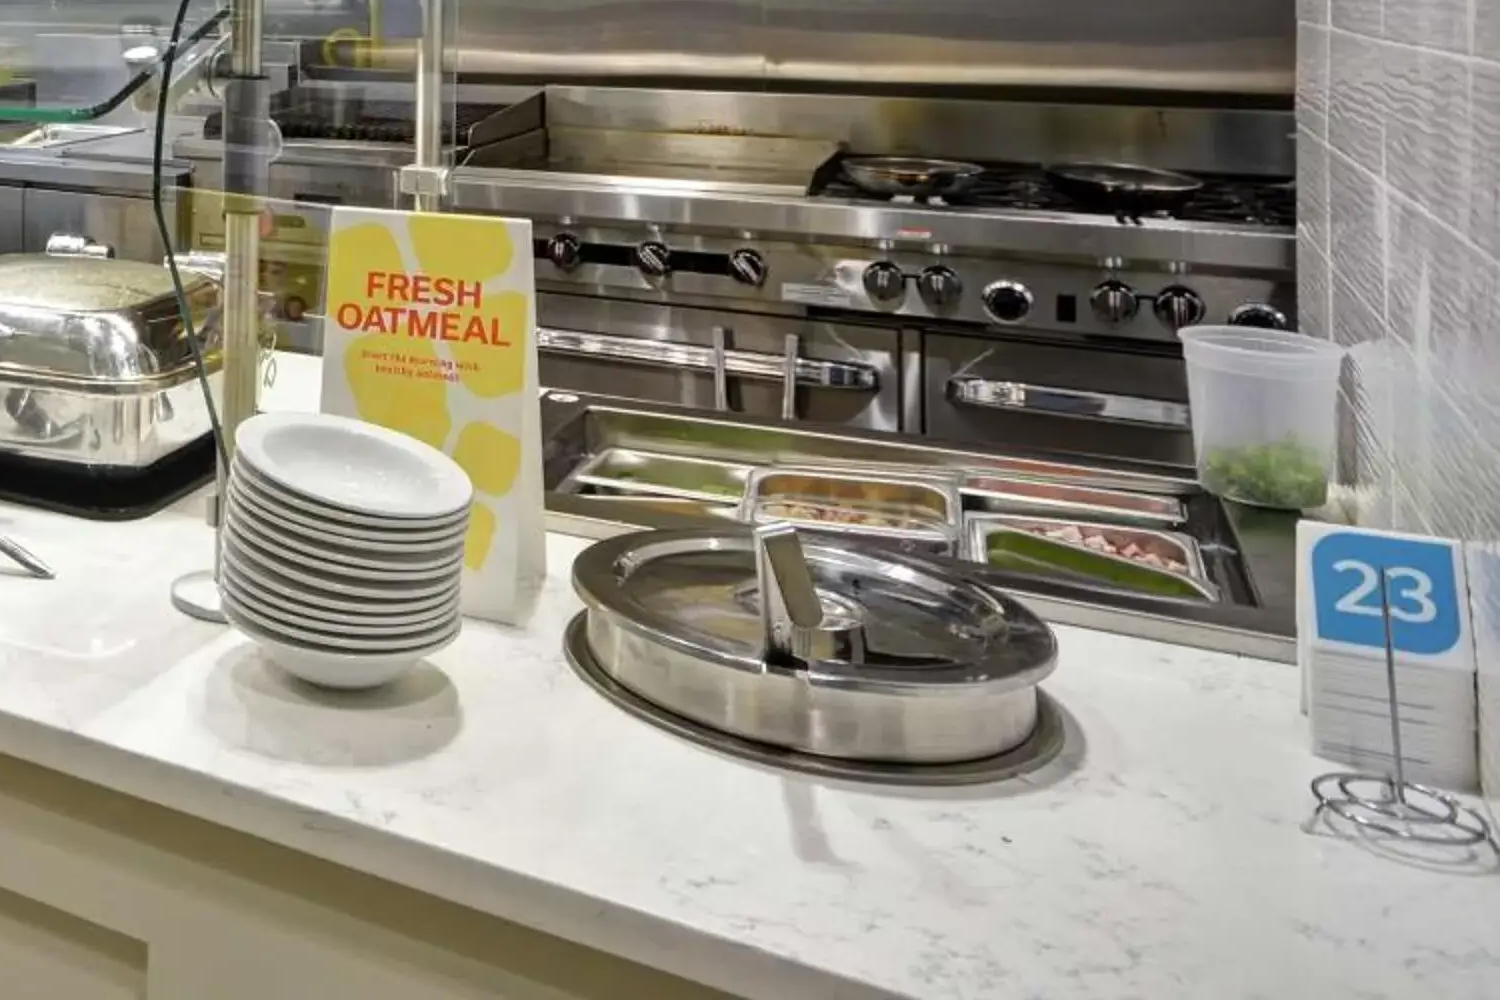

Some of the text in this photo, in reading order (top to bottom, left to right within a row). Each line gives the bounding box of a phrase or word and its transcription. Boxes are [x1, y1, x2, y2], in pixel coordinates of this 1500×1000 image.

[368, 272, 481, 308] FRESH
[338, 304, 510, 346] OATMEAL
[1333, 560, 1437, 622] 23
